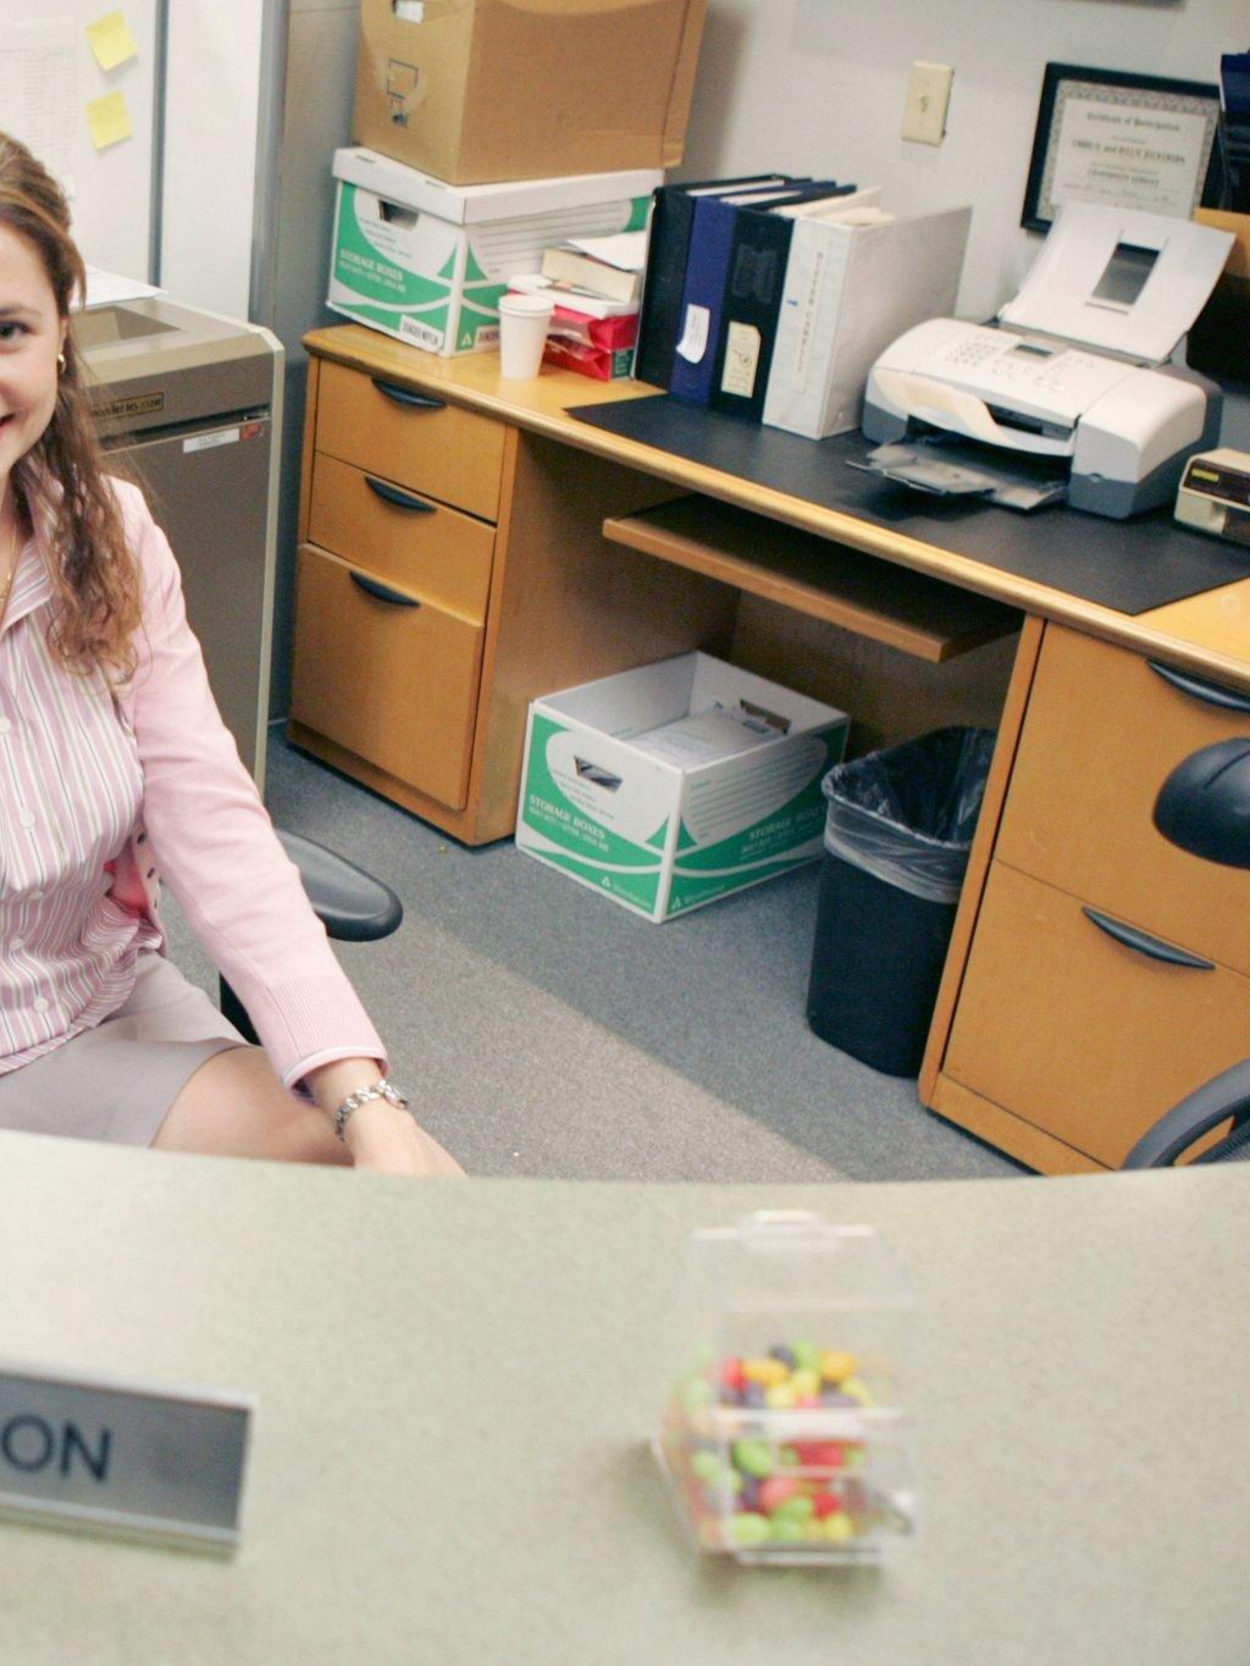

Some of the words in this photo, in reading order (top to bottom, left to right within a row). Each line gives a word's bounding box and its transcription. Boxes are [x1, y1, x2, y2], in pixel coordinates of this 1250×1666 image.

[340, 248, 373, 267] STORAGE
[529, 793, 571, 821] STORAGE
[573, 816, 606, 840] BOXES
[750, 817, 792, 839] STORAGE
